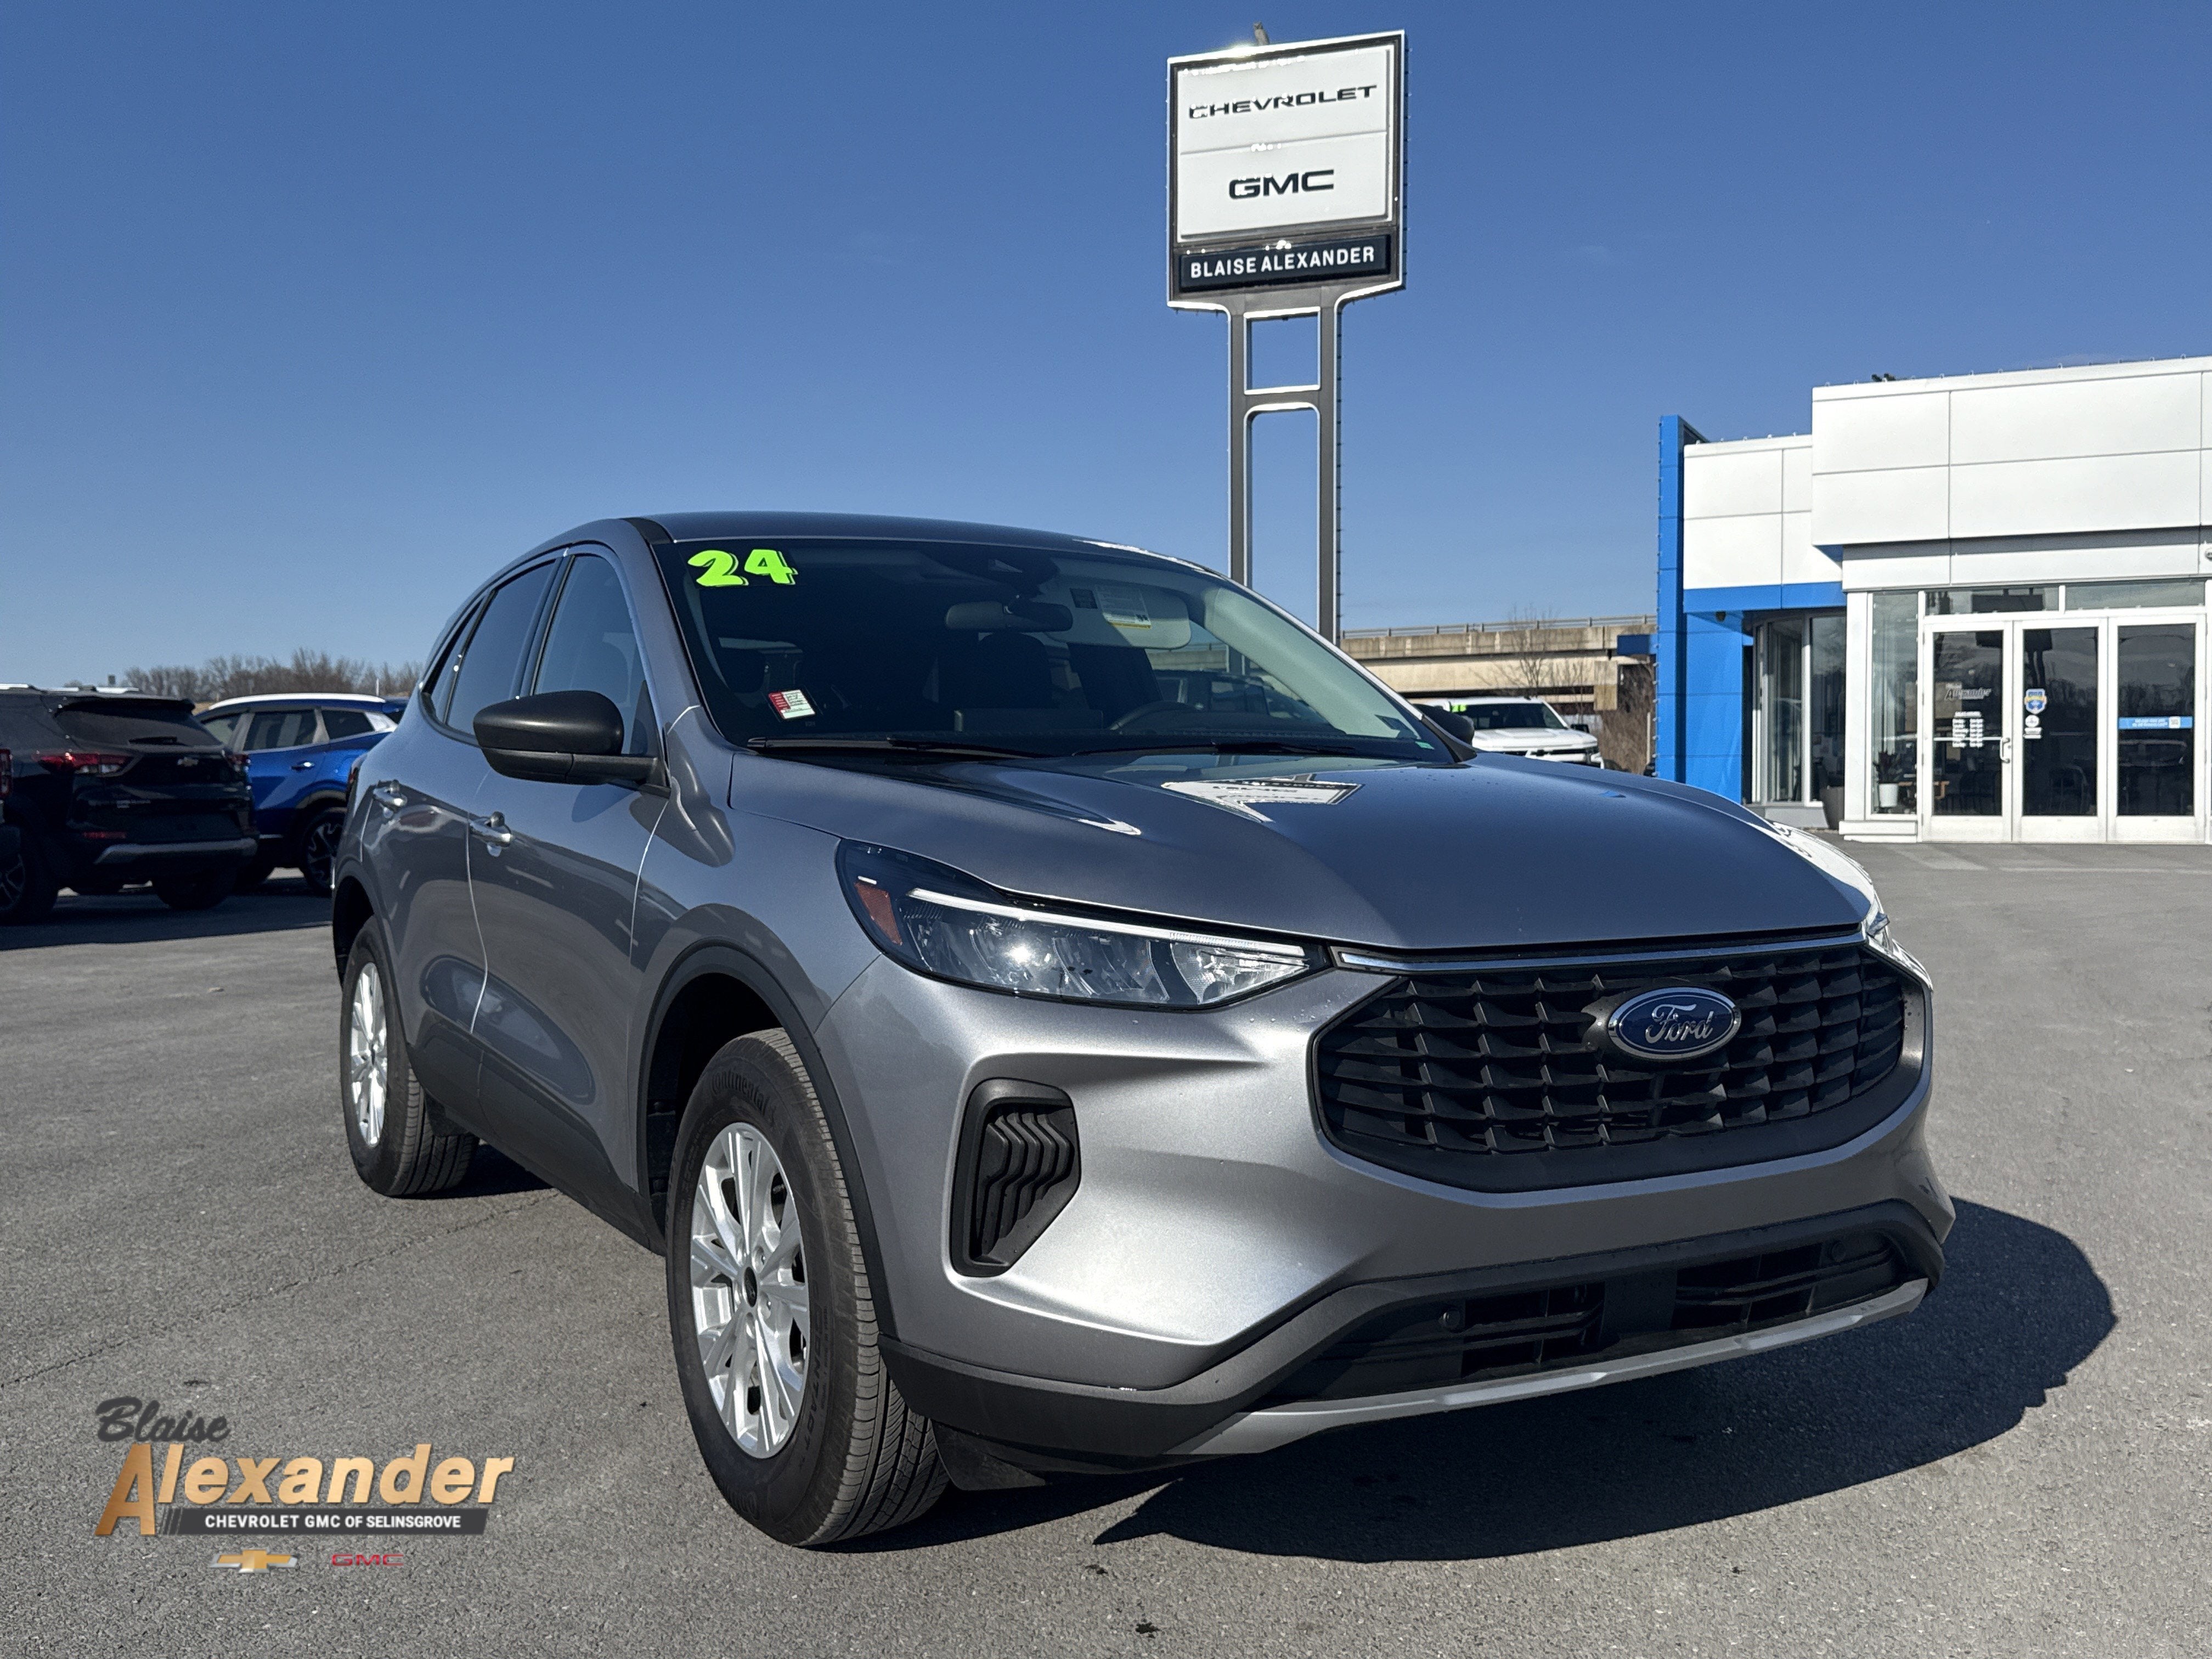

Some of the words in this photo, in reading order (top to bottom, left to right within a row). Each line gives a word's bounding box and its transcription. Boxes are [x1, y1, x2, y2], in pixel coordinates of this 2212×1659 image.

[1189, 84, 1377, 119] CHEVROLET
[1229, 169, 1334, 199] GMC
[1190, 257, 1256, 278] BLAISE
[1261, 246, 1374, 272] ALEXANDER
[687, 549, 798, 586] 24
[1645, 1004, 1713, 1043] Ford
